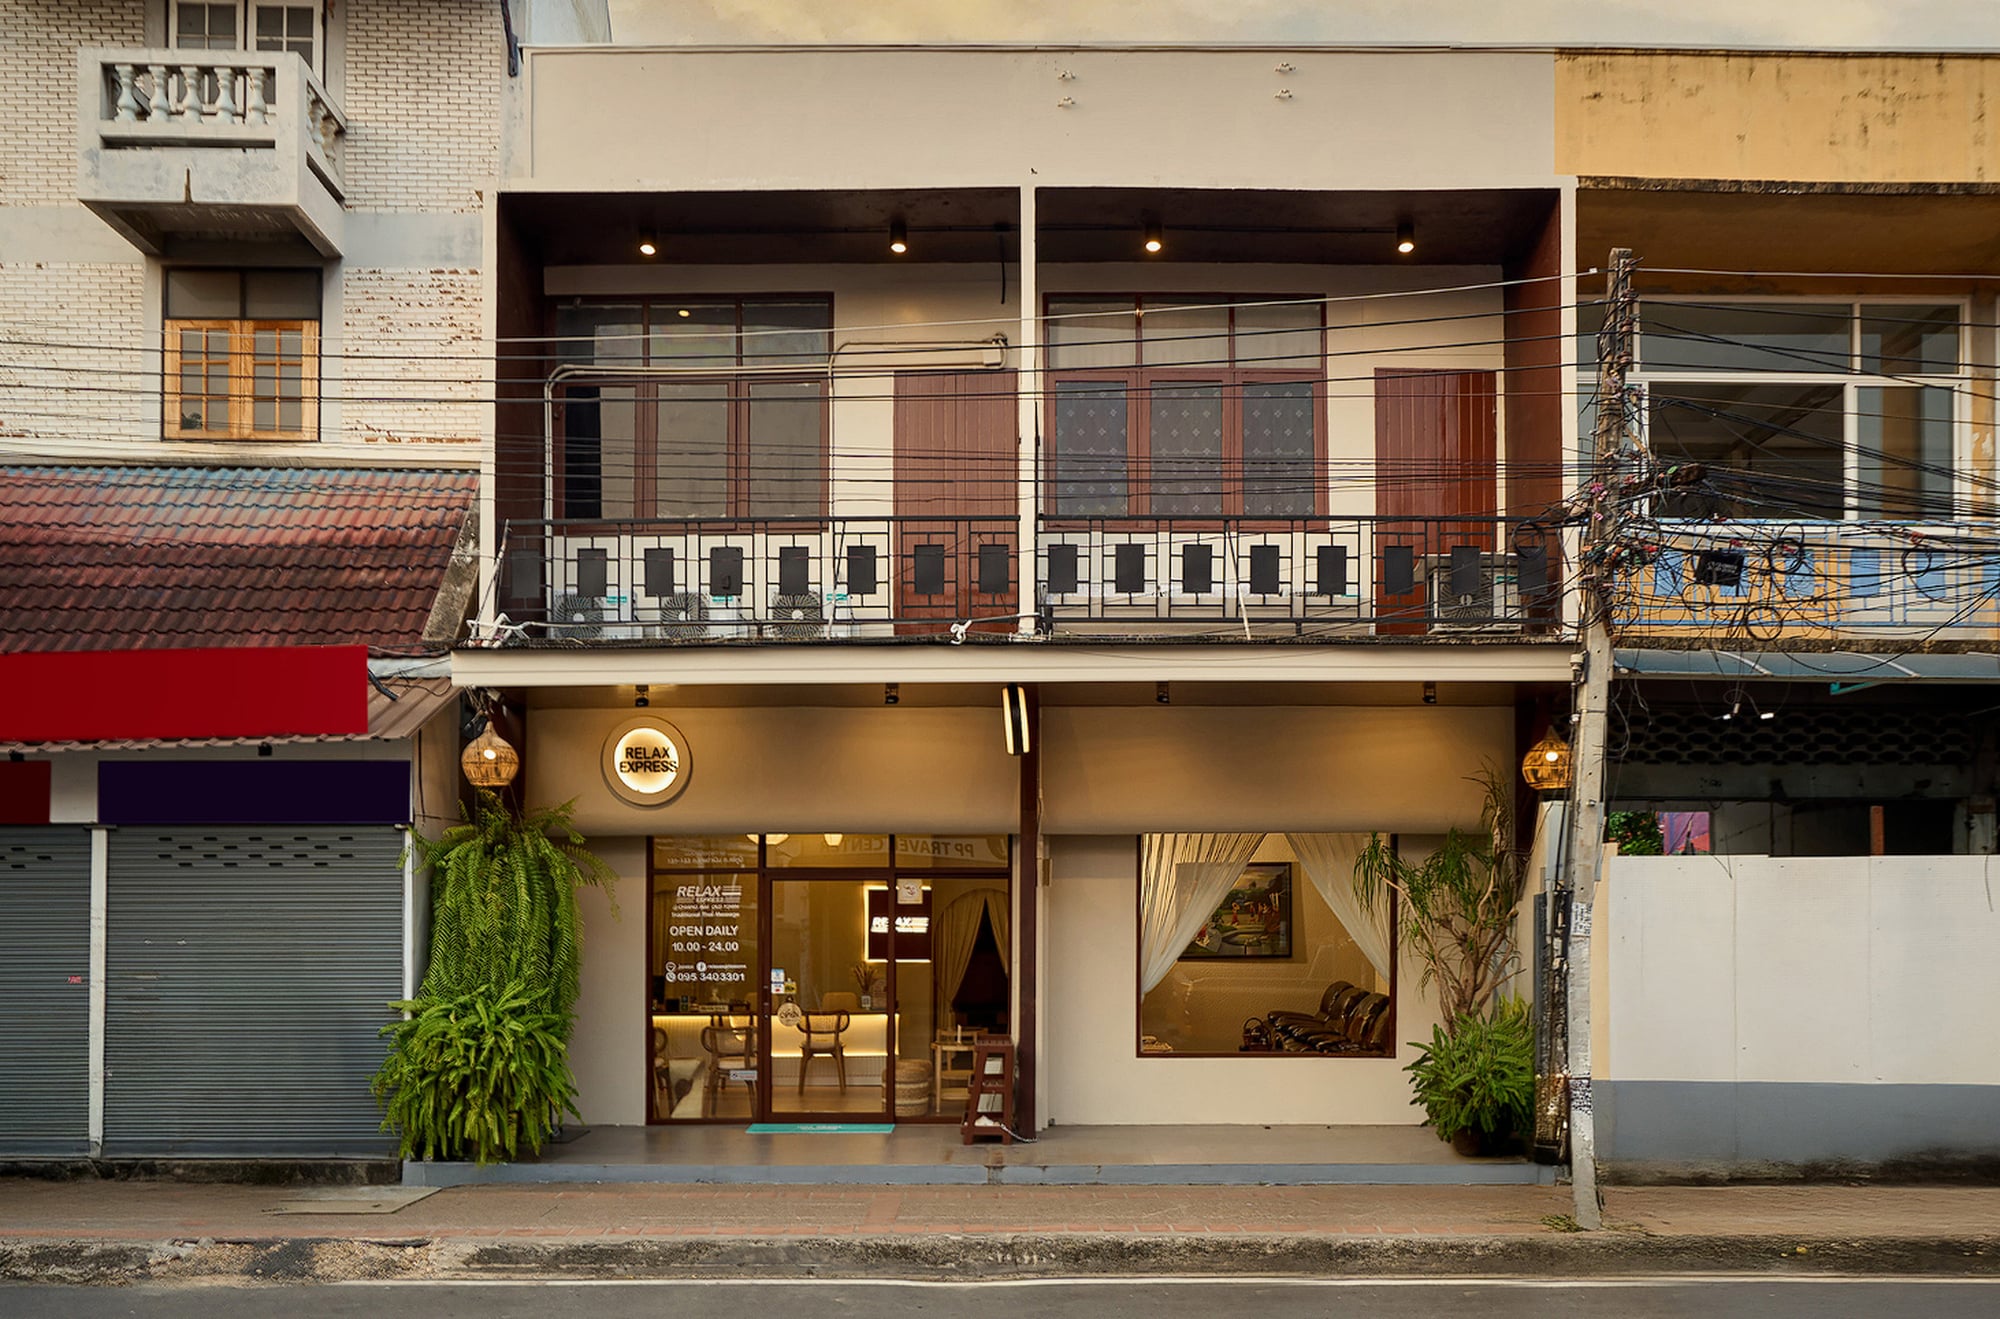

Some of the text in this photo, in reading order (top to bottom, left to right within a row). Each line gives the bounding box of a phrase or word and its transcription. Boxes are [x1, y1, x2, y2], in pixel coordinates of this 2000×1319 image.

[625, 747, 670, 759] RELAX
[620, 760, 678, 773] EXPRESS
[676, 885, 721, 897] RELAX
[669, 925, 739, 937] OPEN DAILY
[672, 941, 701, 952] 10.00
[708, 941, 739, 952] 24.00
[677, 972, 745, 982] 095 3403301
